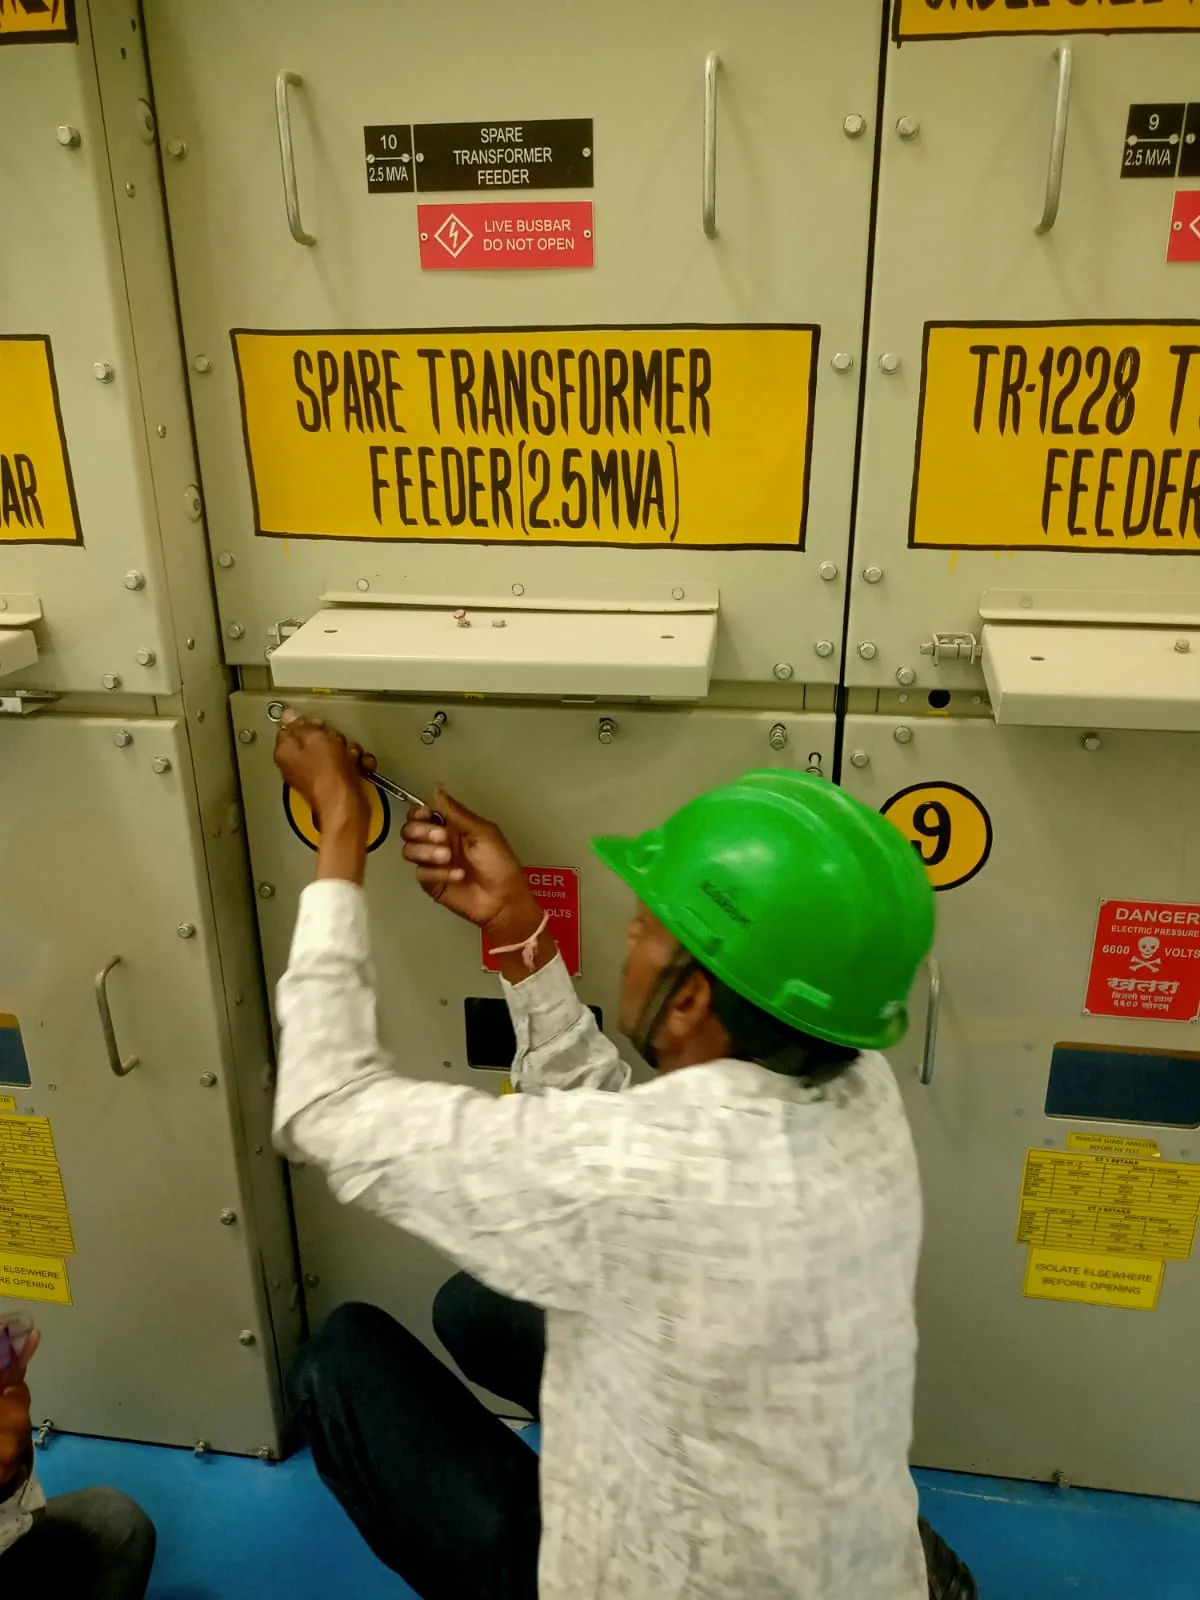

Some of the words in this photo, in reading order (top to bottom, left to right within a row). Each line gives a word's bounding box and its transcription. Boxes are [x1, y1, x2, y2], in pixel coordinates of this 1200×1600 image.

[1148, 114, 1160, 130] 9
[380, 134, 398, 150] 10
[480, 127, 524, 144] SPARE
[453, 147, 552, 165] TRANSFORMER
[1124, 150, 1142, 166] 2.5
[1145, 148, 1170, 166] MVA
[369, 167, 384, 182] 2.5
[386, 166, 408, 182] MVA
[478, 169, 530, 186] FEEDER
[484, 220, 513, 233] LIVE
[516, 218, 571, 232] BUSBAR
[483, 238, 502, 250] DO
[506, 238, 532, 250] NOT
[536, 237, 574, 250] OPEN
[293, 349, 407, 434] SPARE
[417, 348, 712, 438] TRANSFORMER
[969, 345, 1140, 437] TR-1228
[1168, 345, 1200, 437] T
[0, 454, 45, 530] AR
[1042, 448, 1200, 540] FEEDER
[910, 800, 952, 866] 9
[528, 874, 565, 886] GER
[532, 890, 566, 898] RESSURE
[1116, 908, 1200, 924] DANGER
[1112, 925, 1152, 934] ELECTRIC
[1154, 927, 1200, 938] PRESSURE
[1102, 944, 1130, 954] 6600
[1164, 948, 1200, 958] VOLTS
[1106, 977, 1180, 995] खतरा
[4, 1265, 60, 1280] ELSEWHERE
[1035, 1263, 1080, 1274] ISOLATE
[1084, 1268, 1152, 1282] ELSEWHERE
[13, 1278, 56, 1290] OPENING
[1042, 1277, 1087, 1288] BEFORE
[1090, 1282, 1141, 1295] OPENING
